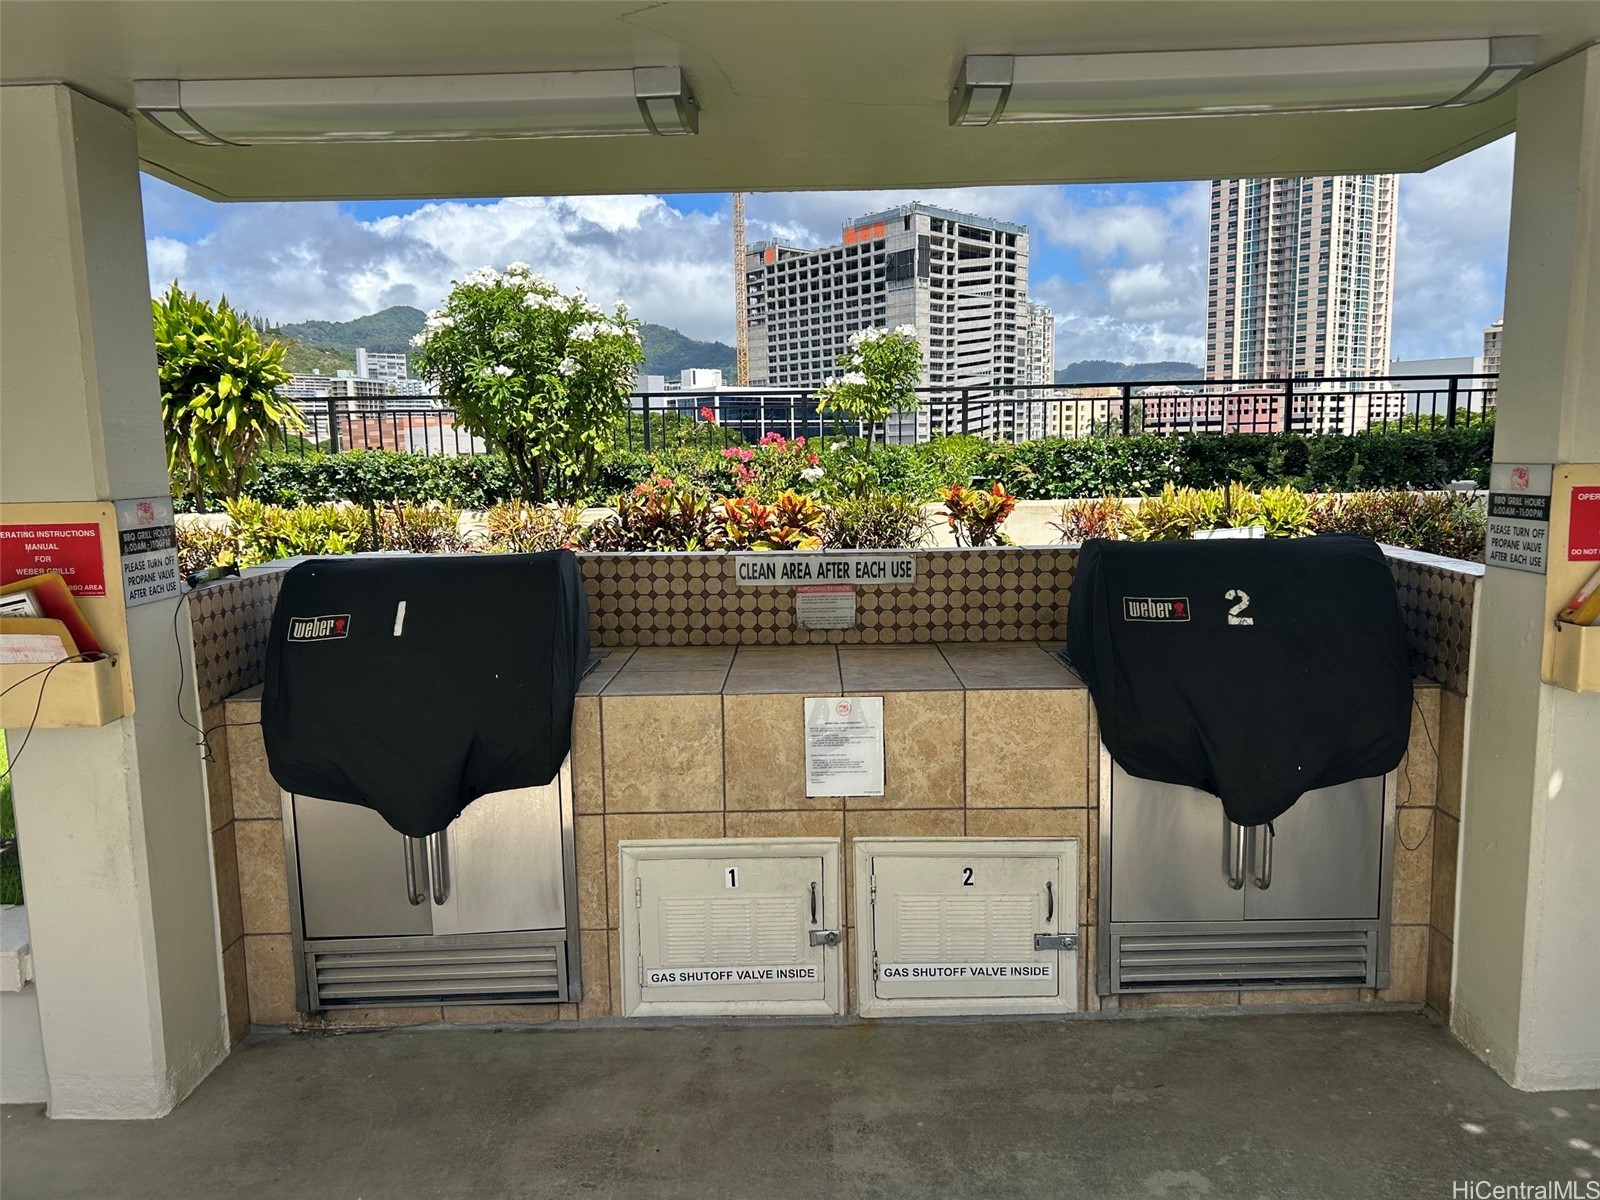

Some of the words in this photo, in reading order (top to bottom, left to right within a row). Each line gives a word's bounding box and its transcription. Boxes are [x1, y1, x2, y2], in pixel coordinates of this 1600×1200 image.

[1494, 495, 1507, 505] BBQ
[1507, 497, 1523, 506] GRILL
[1524, 498, 1546, 508] HOURS
[1578, 493, 1600, 501] OPER
[0, 530, 35, 539] ERATING
[36, 529, 96, 538] INSTRUCTIONS
[123, 532, 136, 542] BBQ
[136, 530, 152, 540] GRILL
[1490, 523, 1511, 536] PLEASE
[1513, 526, 1530, 538] TURN
[1532, 528, 1545, 539] OFF
[24, 543, 60, 551] MANUAL
[1491, 537, 1520, 551] PROPANE
[1522, 541, 1542, 553] VALVE
[34, 555, 52, 563] FOR
[124, 560, 146, 573] PLEASE
[147, 557, 163, 569] TURN
[164, 555, 175, 566] OFF
[1490, 550, 1508, 562] AFTER
[1509, 553, 1527, 565] EACH
[1529, 556, 1542, 567] USE
[15, 568, 45, 576] WEBER
[127, 572, 156, 587] PROPANE
[157, 568, 175, 581] VALVE
[739, 562, 776, 580] CLEAN
[780, 562, 812, 579] AREA
[816, 561, 850, 579] AFTER
[855, 560, 886, 578] EACH
[891, 560, 912, 578] USE
[129, 587, 148, 600] AFTER
[148, 583, 165, 596] EACH
[166, 581, 177, 592] USE
[1128, 598, 1172, 618] weber
[1225, 589, 1254, 625] 2
[293, 617, 335, 638] weber
[728, 869, 736, 887] 1
[962, 867, 974, 886] 2
[651, 973, 676, 983] GAS
[679, 971, 733, 982] SHUTOFF
[736, 970, 773, 980] VALVE
[776, 969, 815, 979] INSIDE
[884, 968, 909, 977] GAS
[912, 967, 967, 977] SHUTOFF
[970, 967, 1007, 976] VALVE
[1010, 967, 1050, 976] INSIDE
